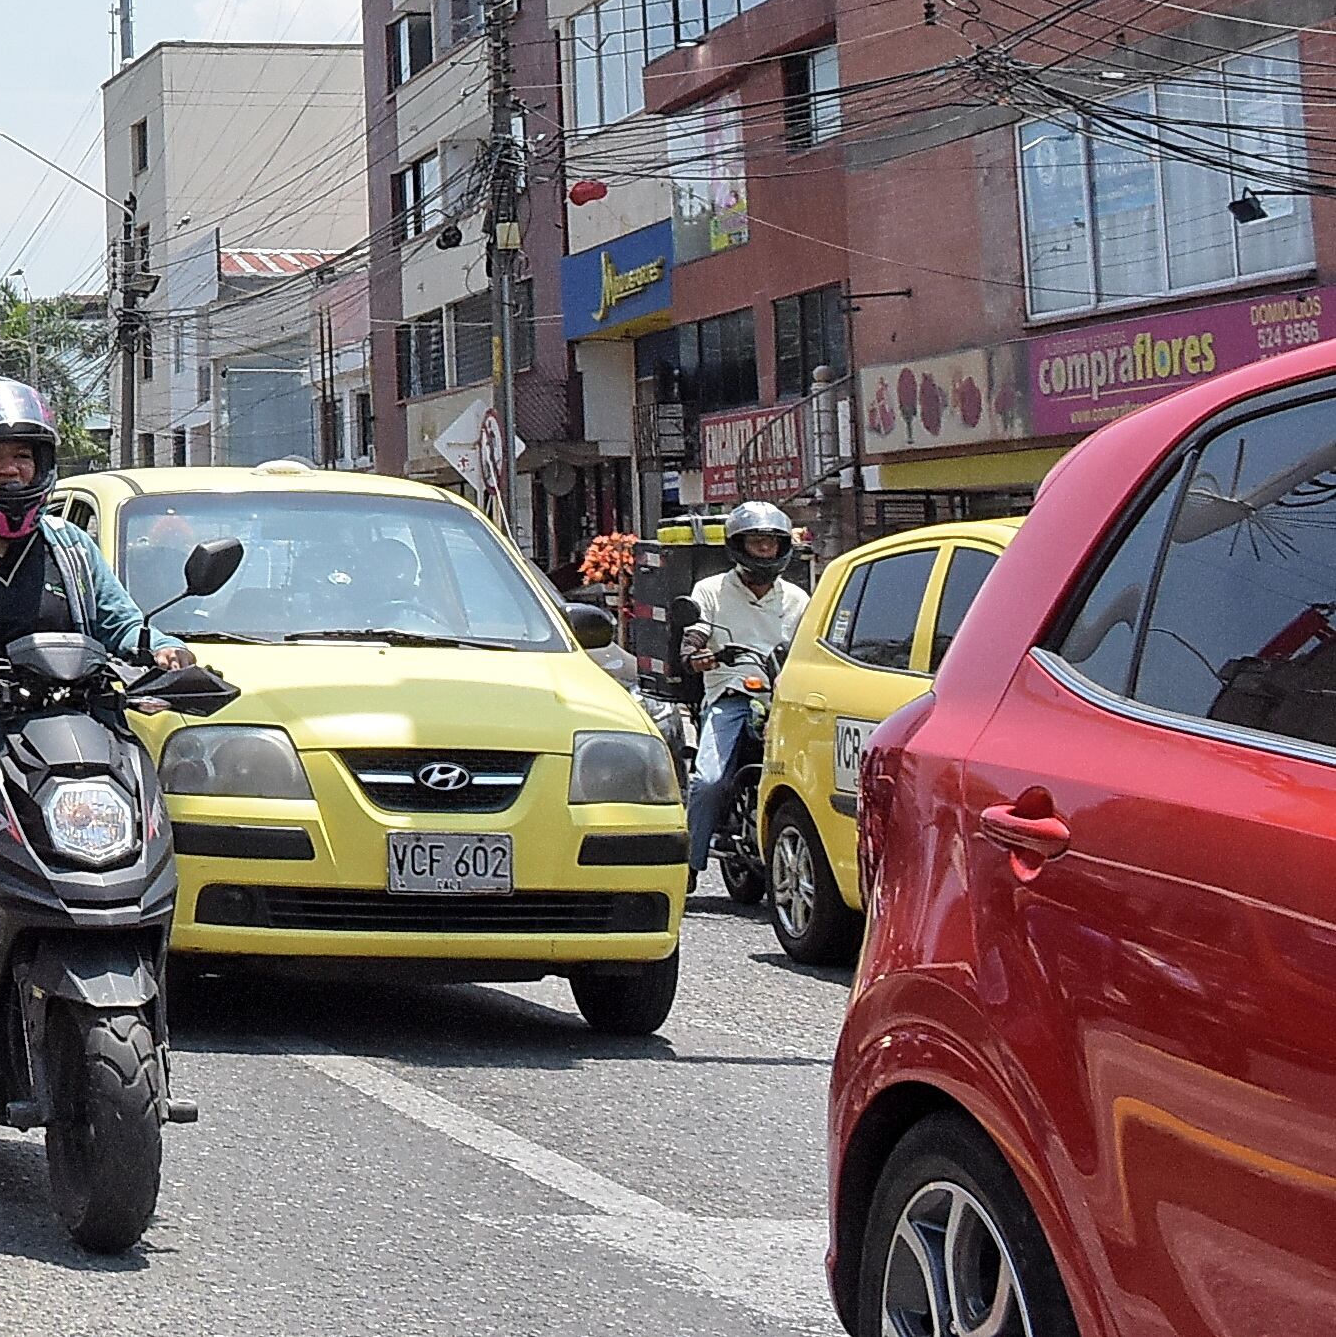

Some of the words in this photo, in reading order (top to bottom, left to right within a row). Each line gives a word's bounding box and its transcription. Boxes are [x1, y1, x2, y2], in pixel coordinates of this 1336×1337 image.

[1038, 331, 1217, 401] compraflores
[836, 725, 861, 770] VCR
[392, 843, 445, 877] VCF
[454, 844, 509, 879] 602
